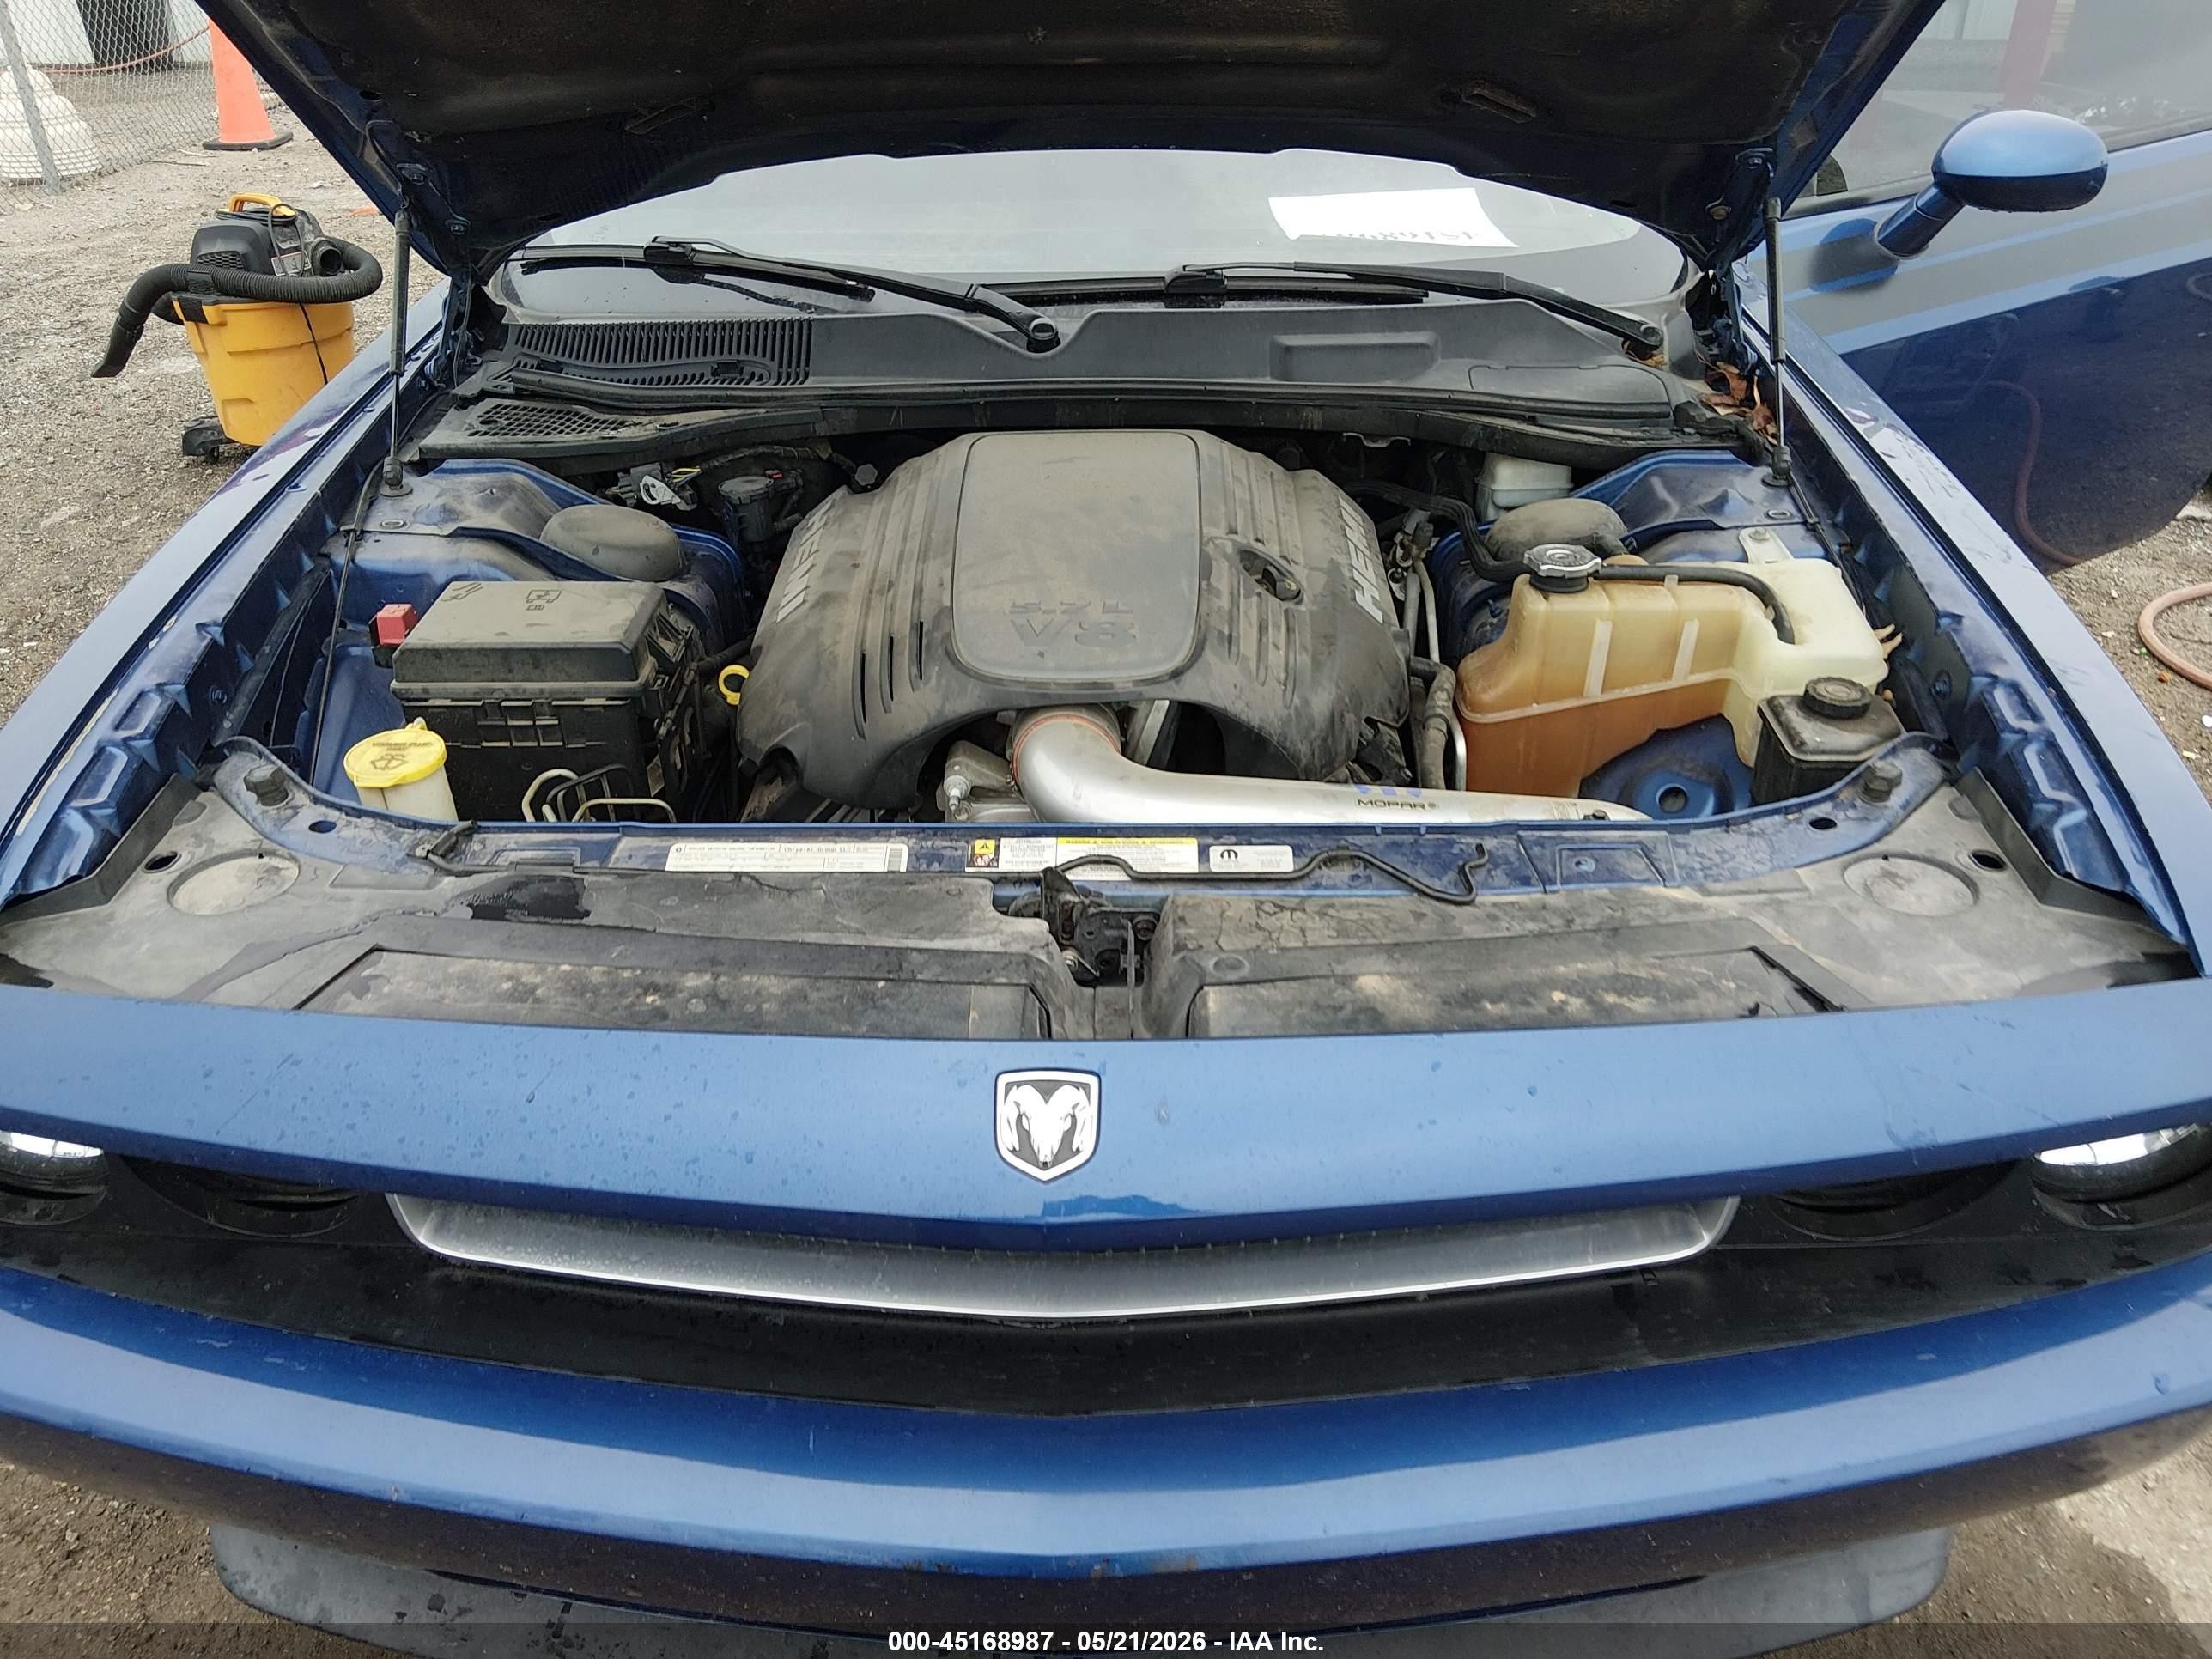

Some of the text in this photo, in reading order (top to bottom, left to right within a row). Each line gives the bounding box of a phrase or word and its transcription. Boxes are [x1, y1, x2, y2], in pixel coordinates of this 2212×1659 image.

[776, 499, 835, 624] HEMI
[1339, 495, 1384, 624] HEMI
[1010, 617, 1137, 647] V8
